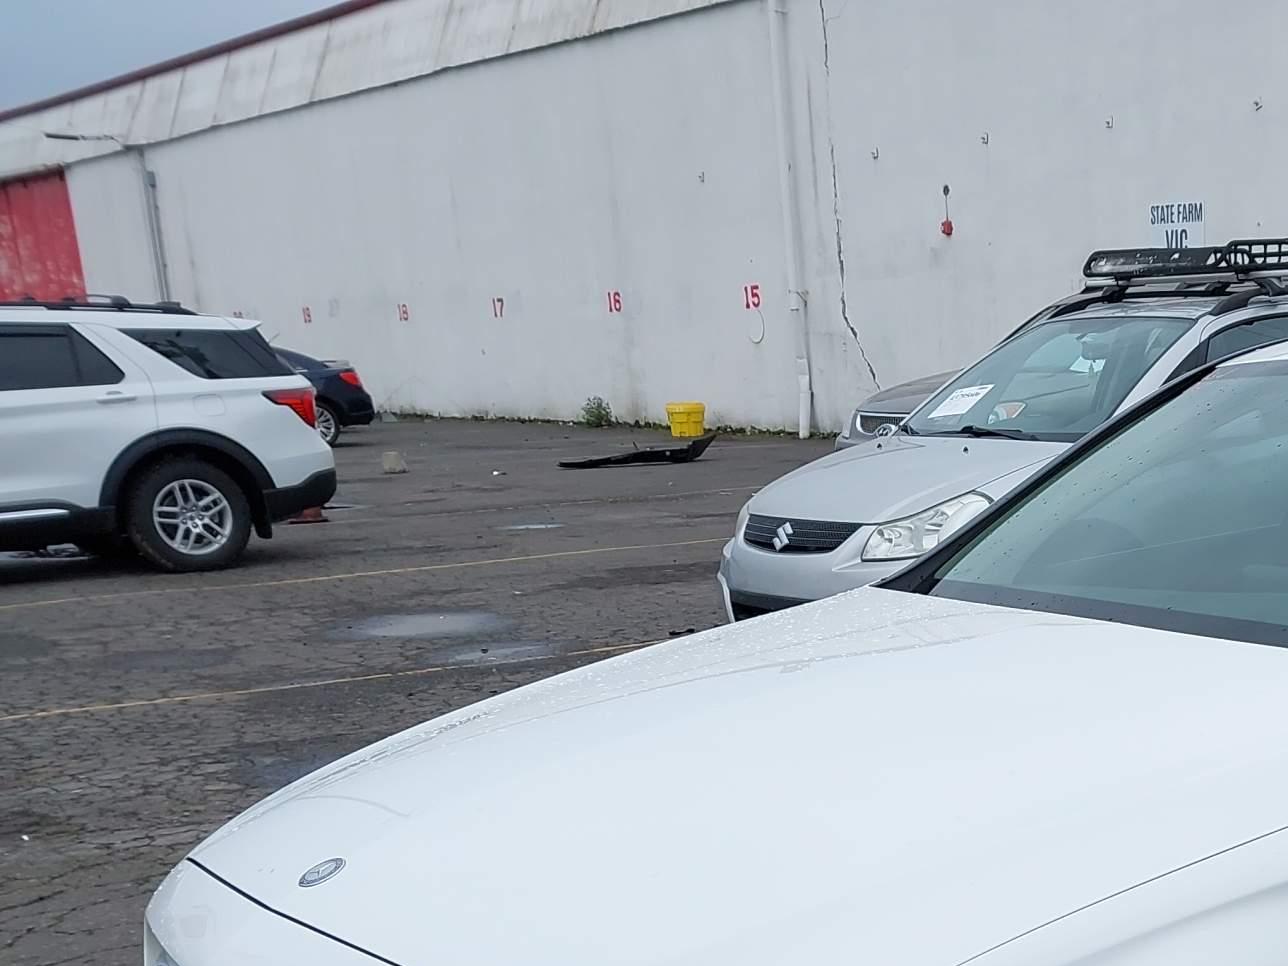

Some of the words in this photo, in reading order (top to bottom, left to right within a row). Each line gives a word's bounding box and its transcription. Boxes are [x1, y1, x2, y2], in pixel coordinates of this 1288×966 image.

[1150, 204, 1175, 225] STATE
[1177, 202, 1203, 223] FARM
[492, 297, 504, 318] 17
[607, 291, 622, 313] 16
[744, 285, 760, 309] 15
